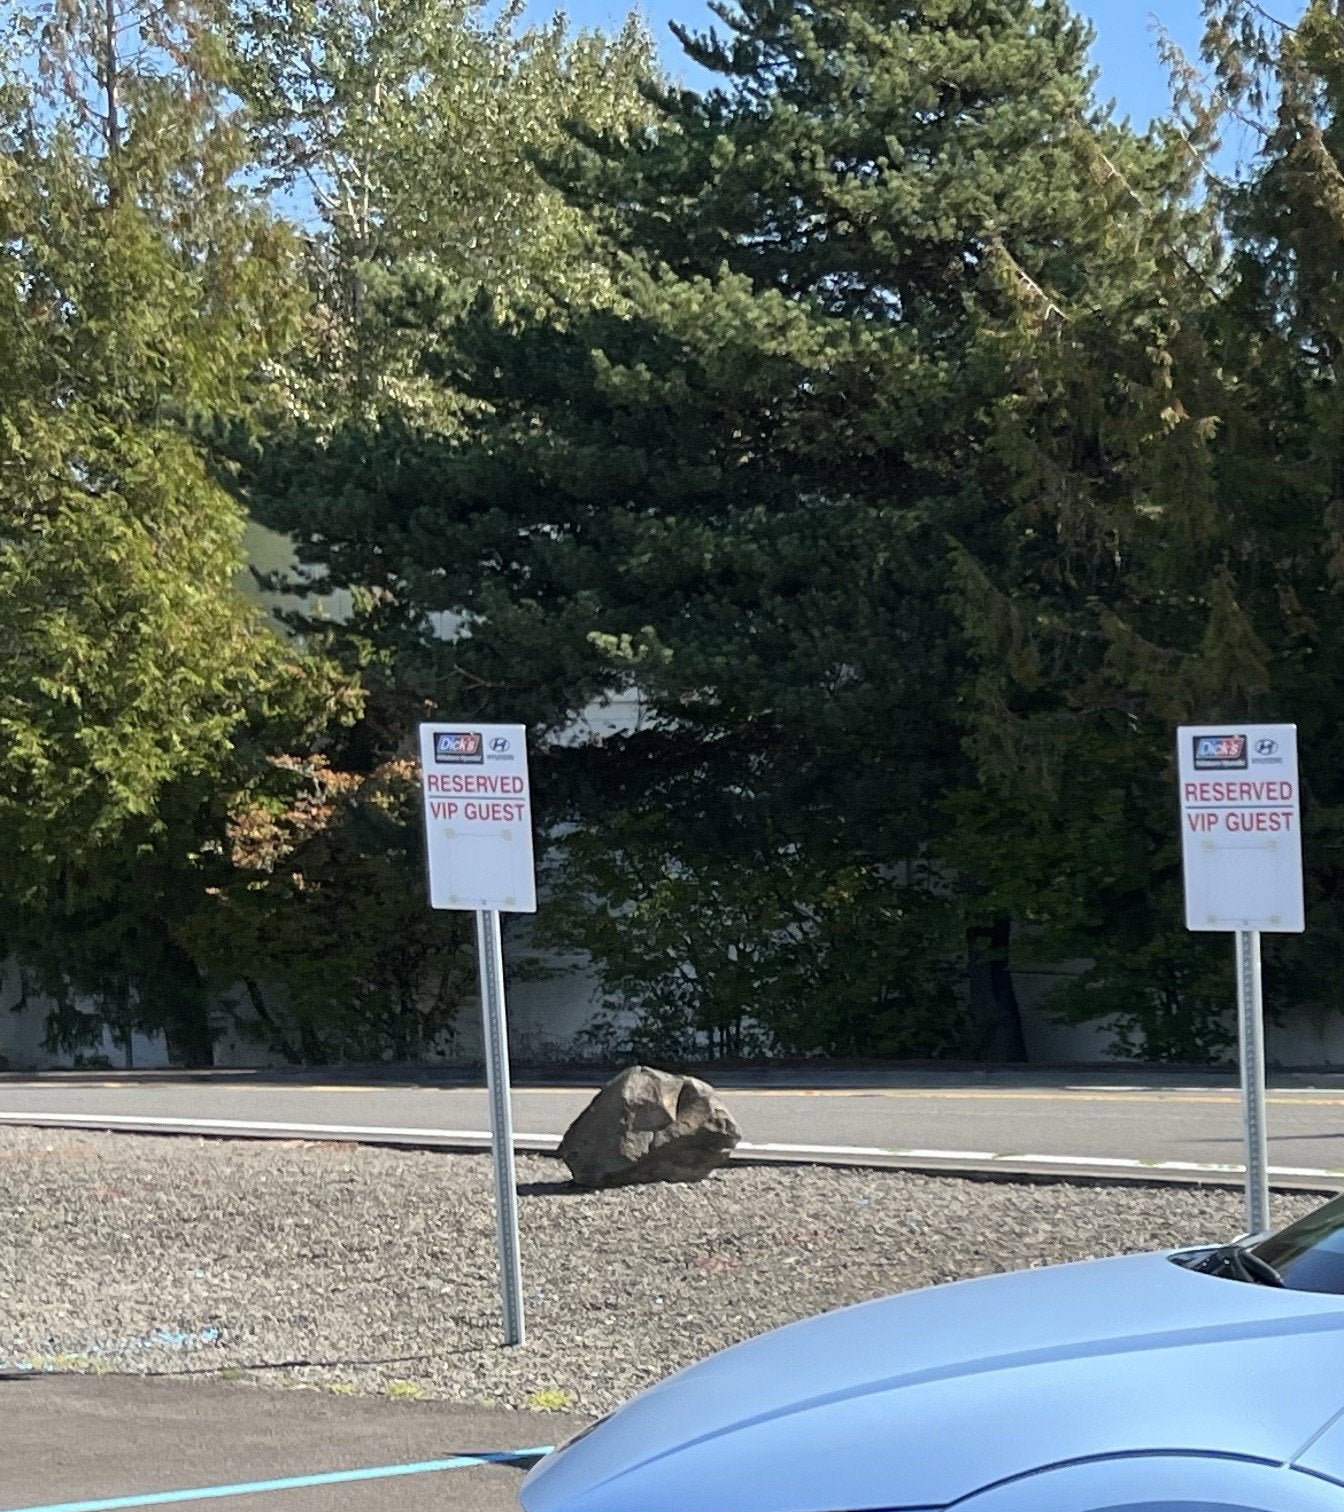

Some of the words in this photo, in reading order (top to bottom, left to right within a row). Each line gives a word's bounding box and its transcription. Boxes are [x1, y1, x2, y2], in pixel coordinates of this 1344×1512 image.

[427, 775, 524, 794] RESERVED
[1185, 782, 1293, 802] RESERVED
[430, 801, 458, 820] VIP
[464, 802, 525, 822] GUEST
[1187, 812, 1219, 832] VIP
[1225, 811, 1293, 832] GUEST
